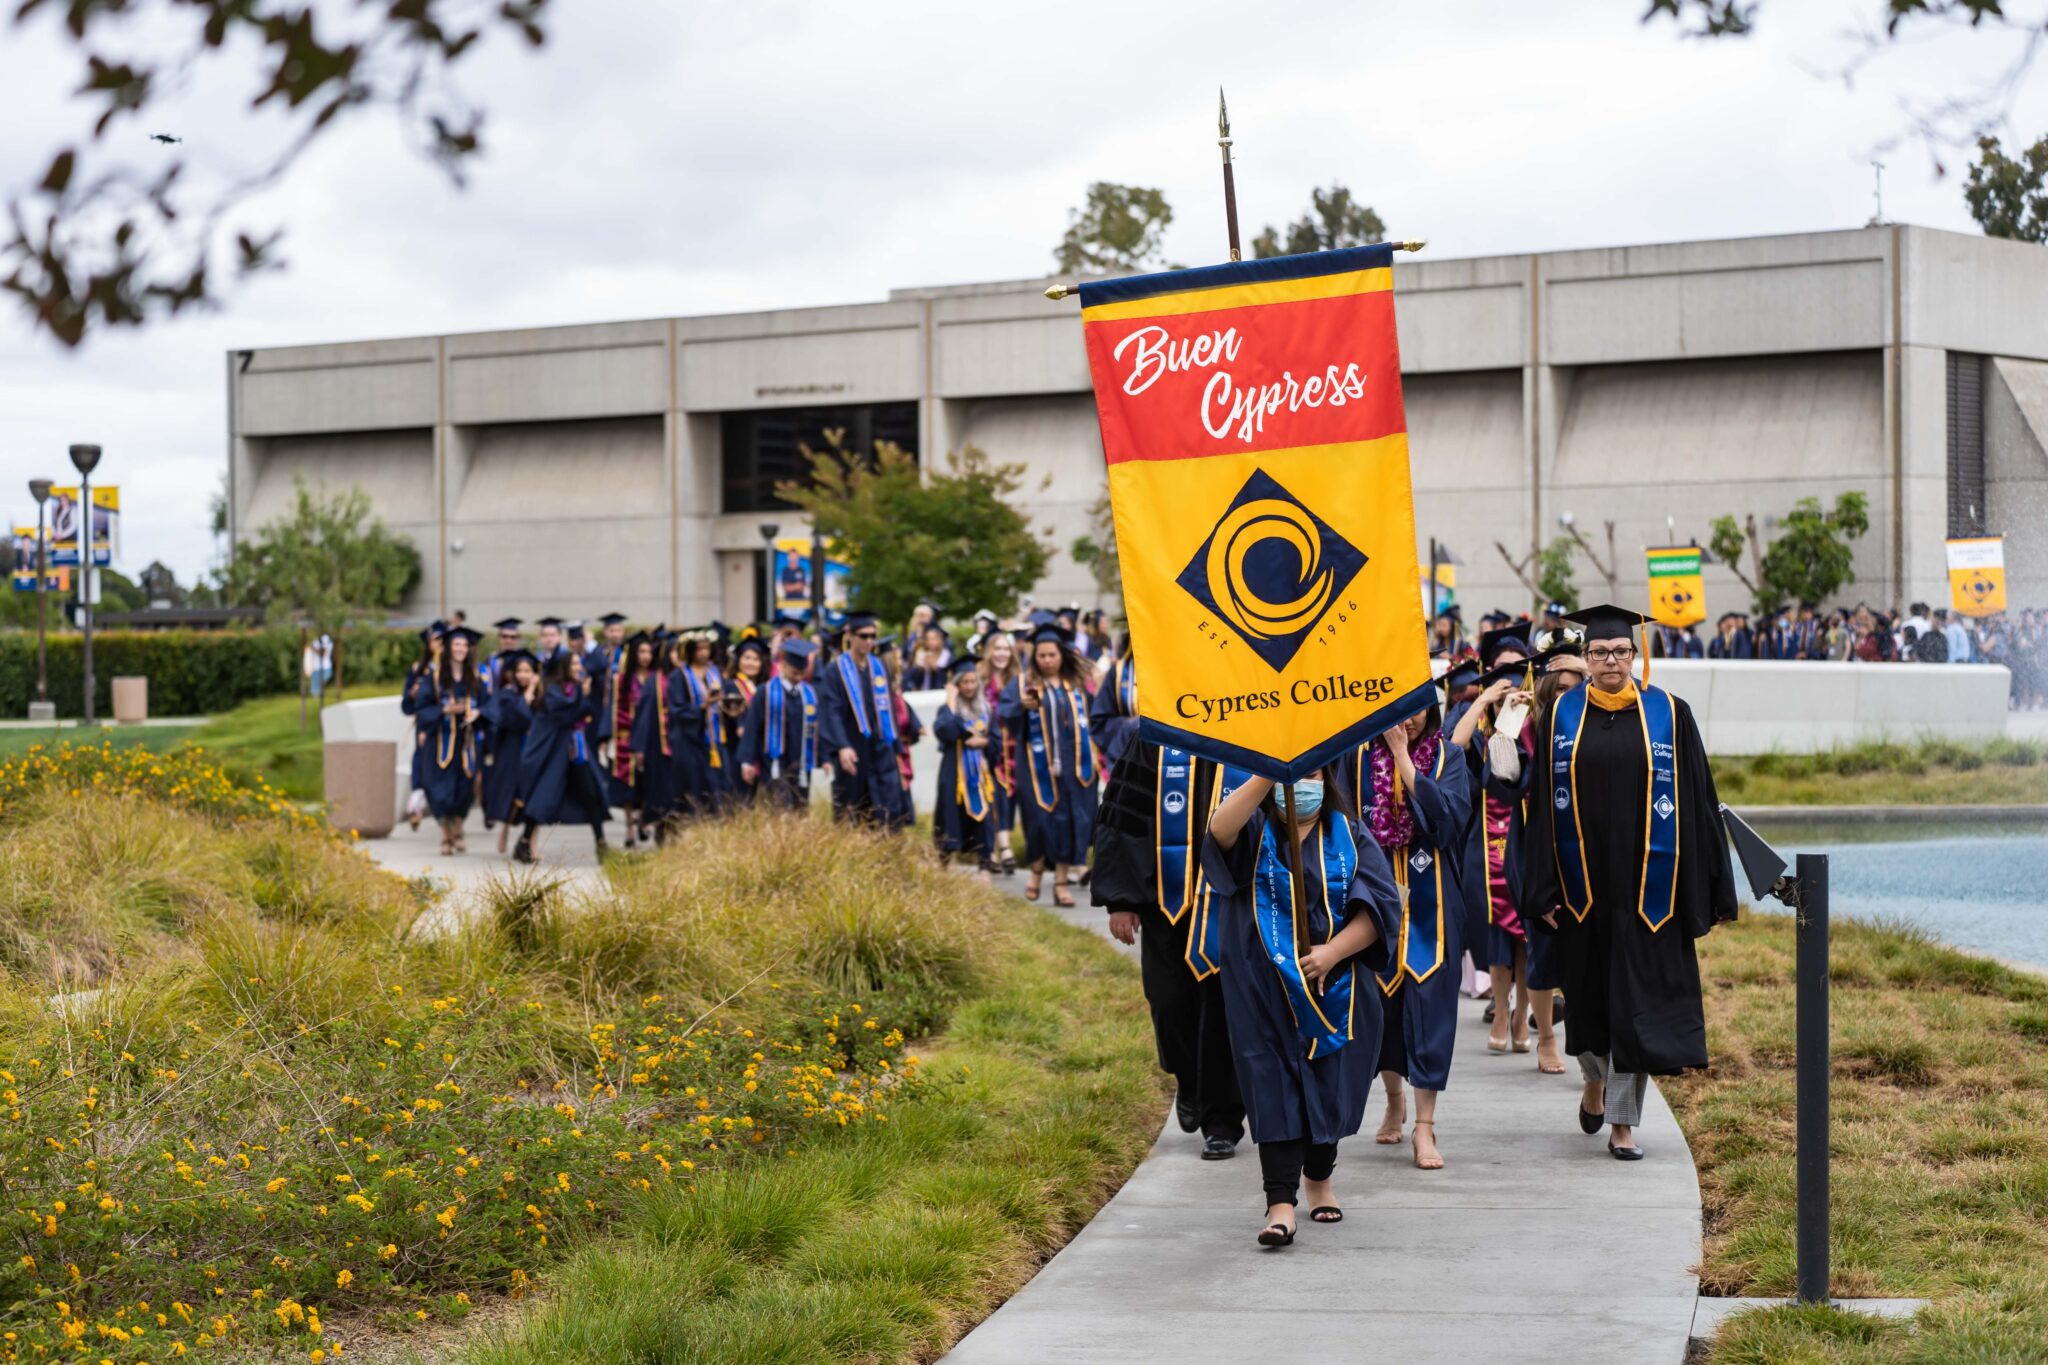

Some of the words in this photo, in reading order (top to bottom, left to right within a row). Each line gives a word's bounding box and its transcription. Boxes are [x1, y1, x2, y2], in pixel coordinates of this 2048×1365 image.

[238, 350, 255, 374] 7
[1113, 325, 1243, 396] Buen
[1200, 362, 1368, 443] Cypress
[1197, 621, 1228, 650] Est
[1318, 599, 1358, 647] 1966
[1175, 690, 1282, 723] Cypress
[1290, 674, 1395, 706] College
[1266, 851, 1276, 899] CYPRESS
[1271, 903, 1279, 947] COLLEGE
